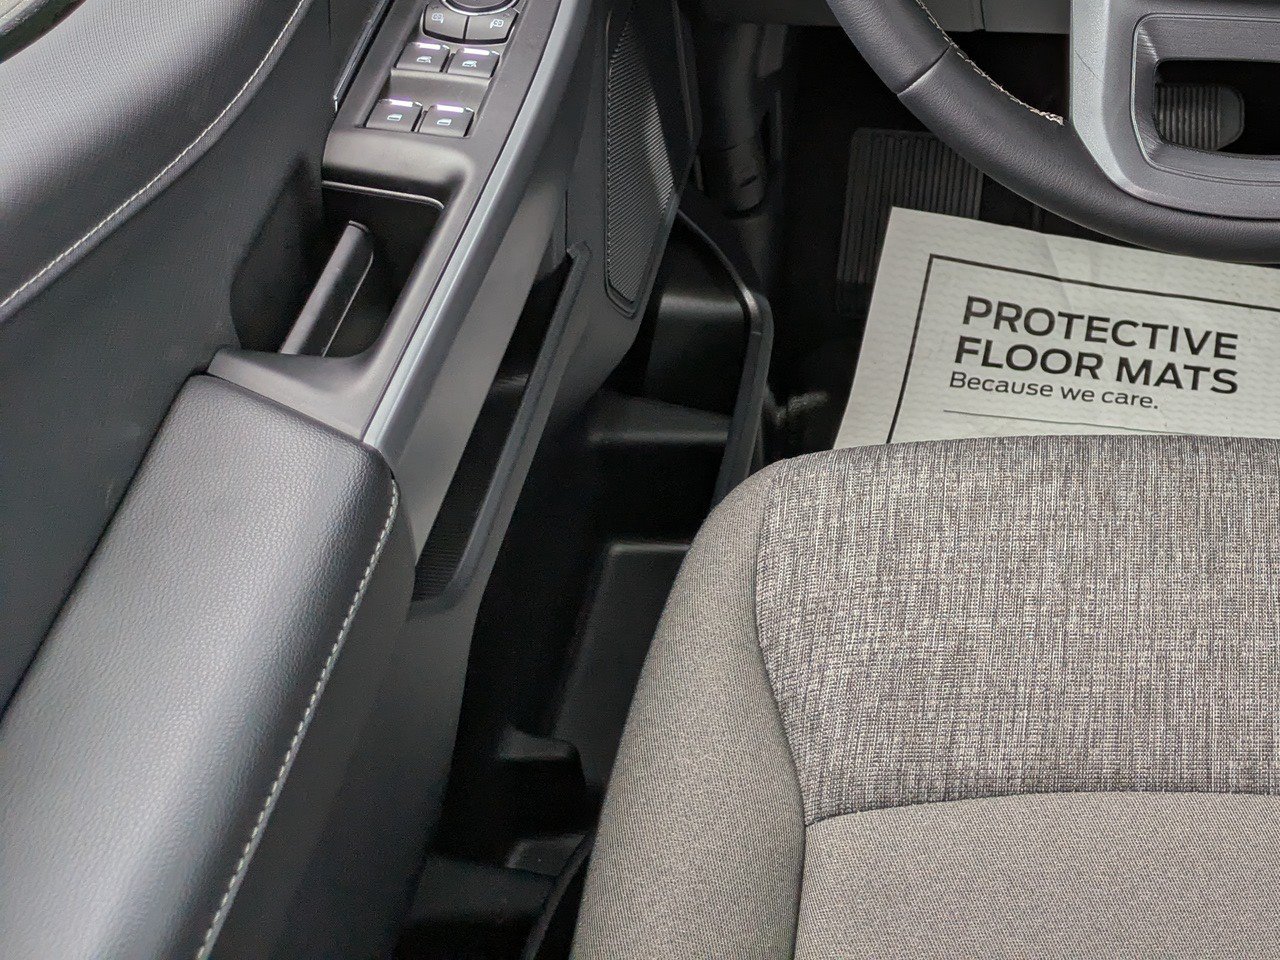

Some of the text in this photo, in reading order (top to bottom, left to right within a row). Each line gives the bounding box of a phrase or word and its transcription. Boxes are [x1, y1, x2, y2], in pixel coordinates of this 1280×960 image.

[962, 295, 1239, 361] PROTECTIVE
[949, 371, 1159, 410] Because we care.
[954, 335, 1240, 395] FLOOR MATS
